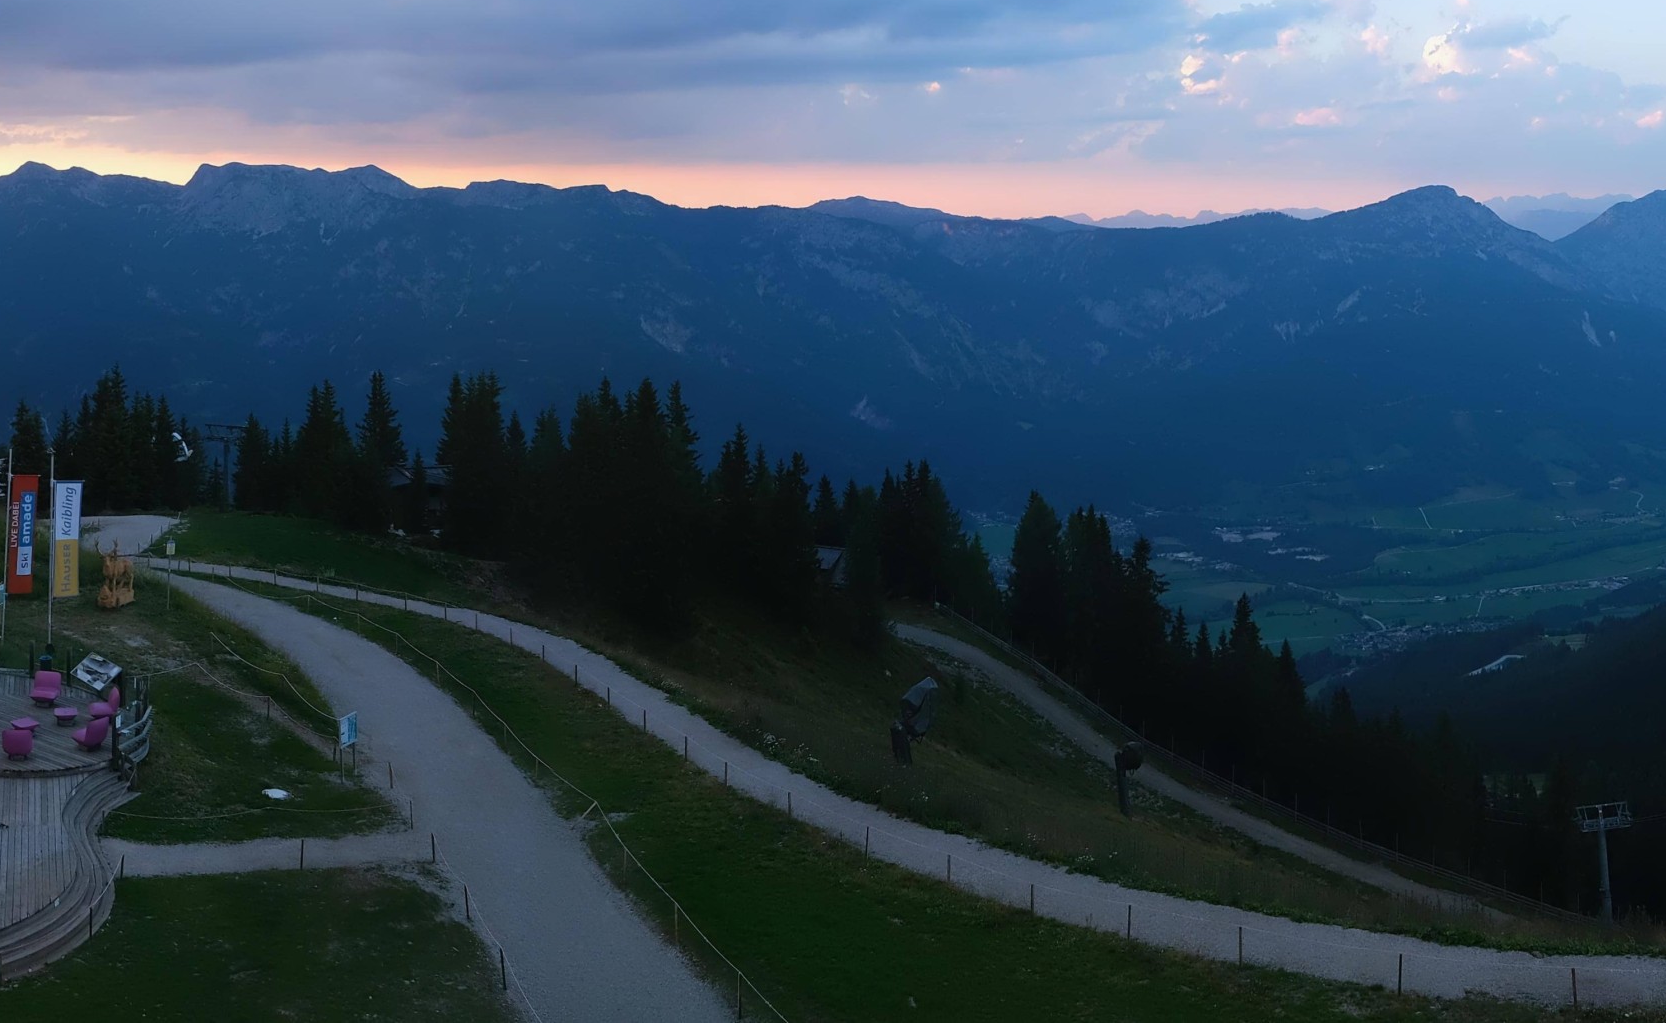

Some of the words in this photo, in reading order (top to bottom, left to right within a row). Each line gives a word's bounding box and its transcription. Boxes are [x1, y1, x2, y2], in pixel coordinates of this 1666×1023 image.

[12, 501, 20, 527] DABEI
[61, 486, 77, 537] Kaibling
[10, 528, 18, 548] LIVE
[21, 553, 29, 569] Ski
[61, 543, 71, 593] HAUSER
